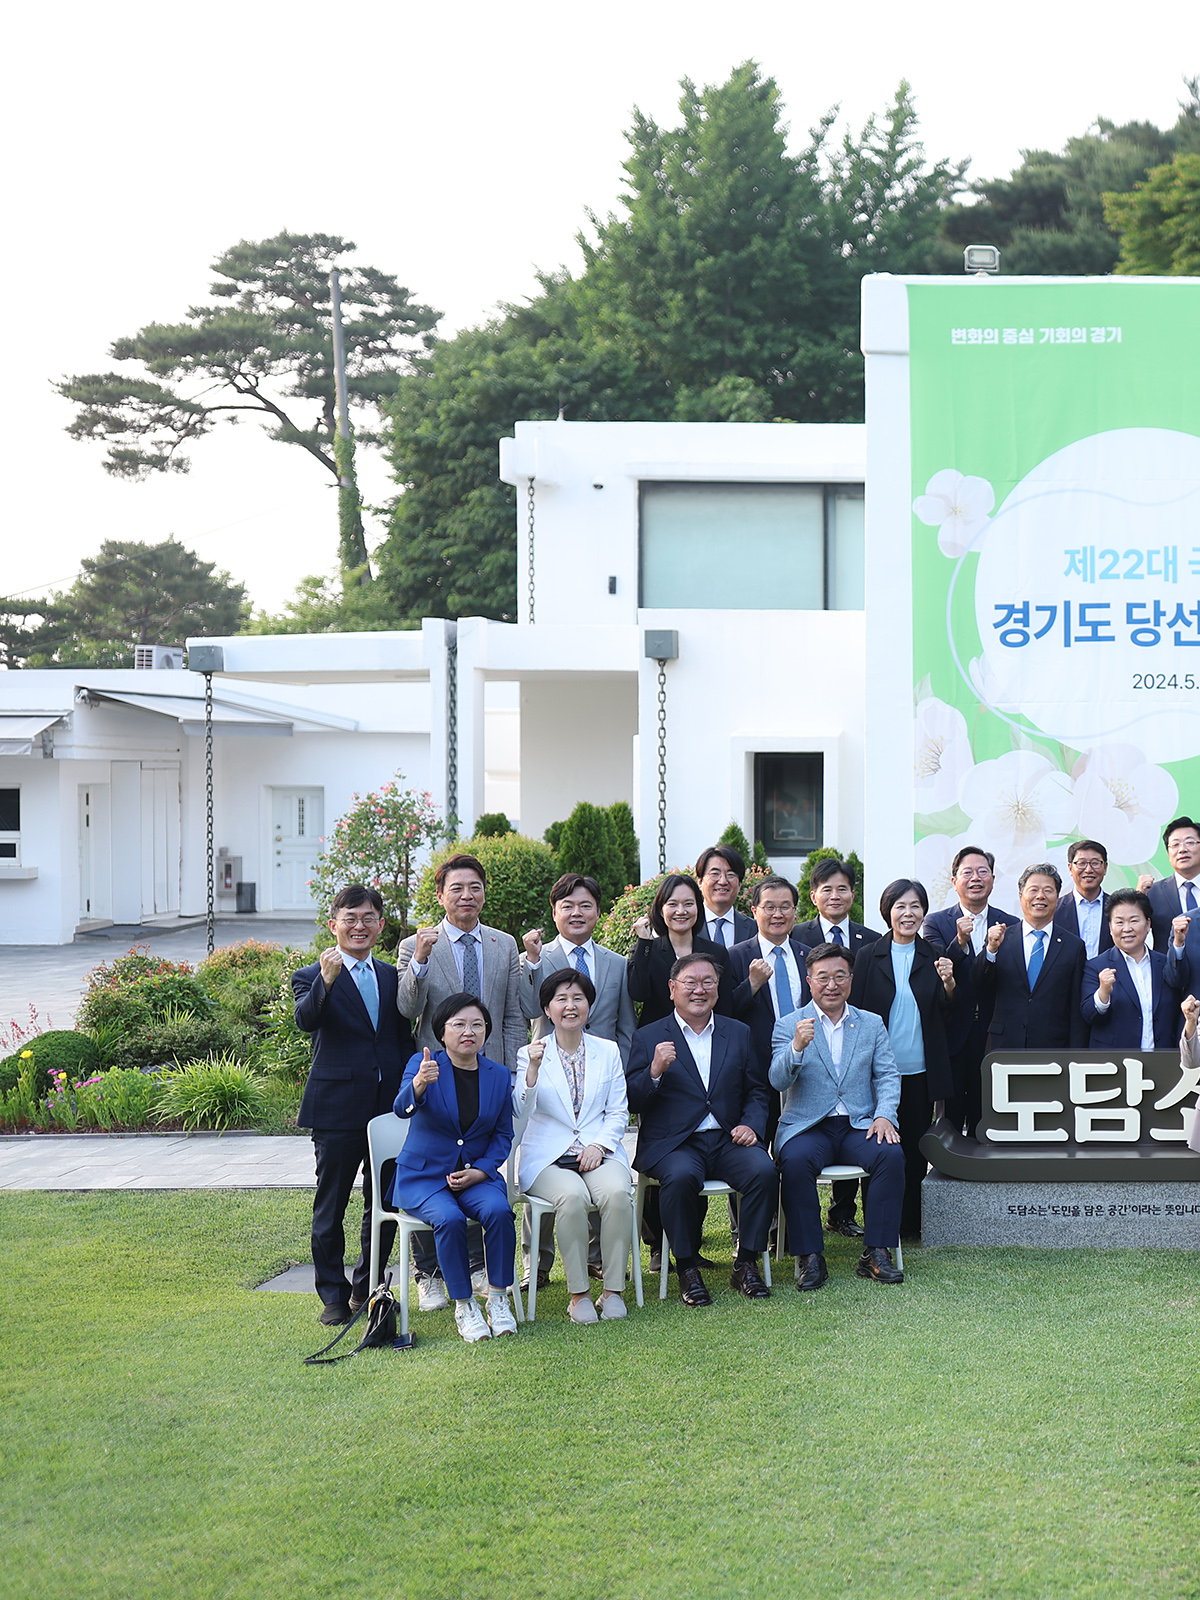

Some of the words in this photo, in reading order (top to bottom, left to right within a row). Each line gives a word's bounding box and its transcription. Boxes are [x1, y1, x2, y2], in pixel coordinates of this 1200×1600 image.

[951, 327, 999, 345] 변화의
[1002, 327, 1035, 345] 중심
[1039, 327, 1087, 344] 기회의
[1090, 326, 1123, 344] 경기
[1063, 545, 1179, 585] 제22대
[991, 599, 1117, 649] 경기도
[1084, 1204, 1104, 1217] 담은
